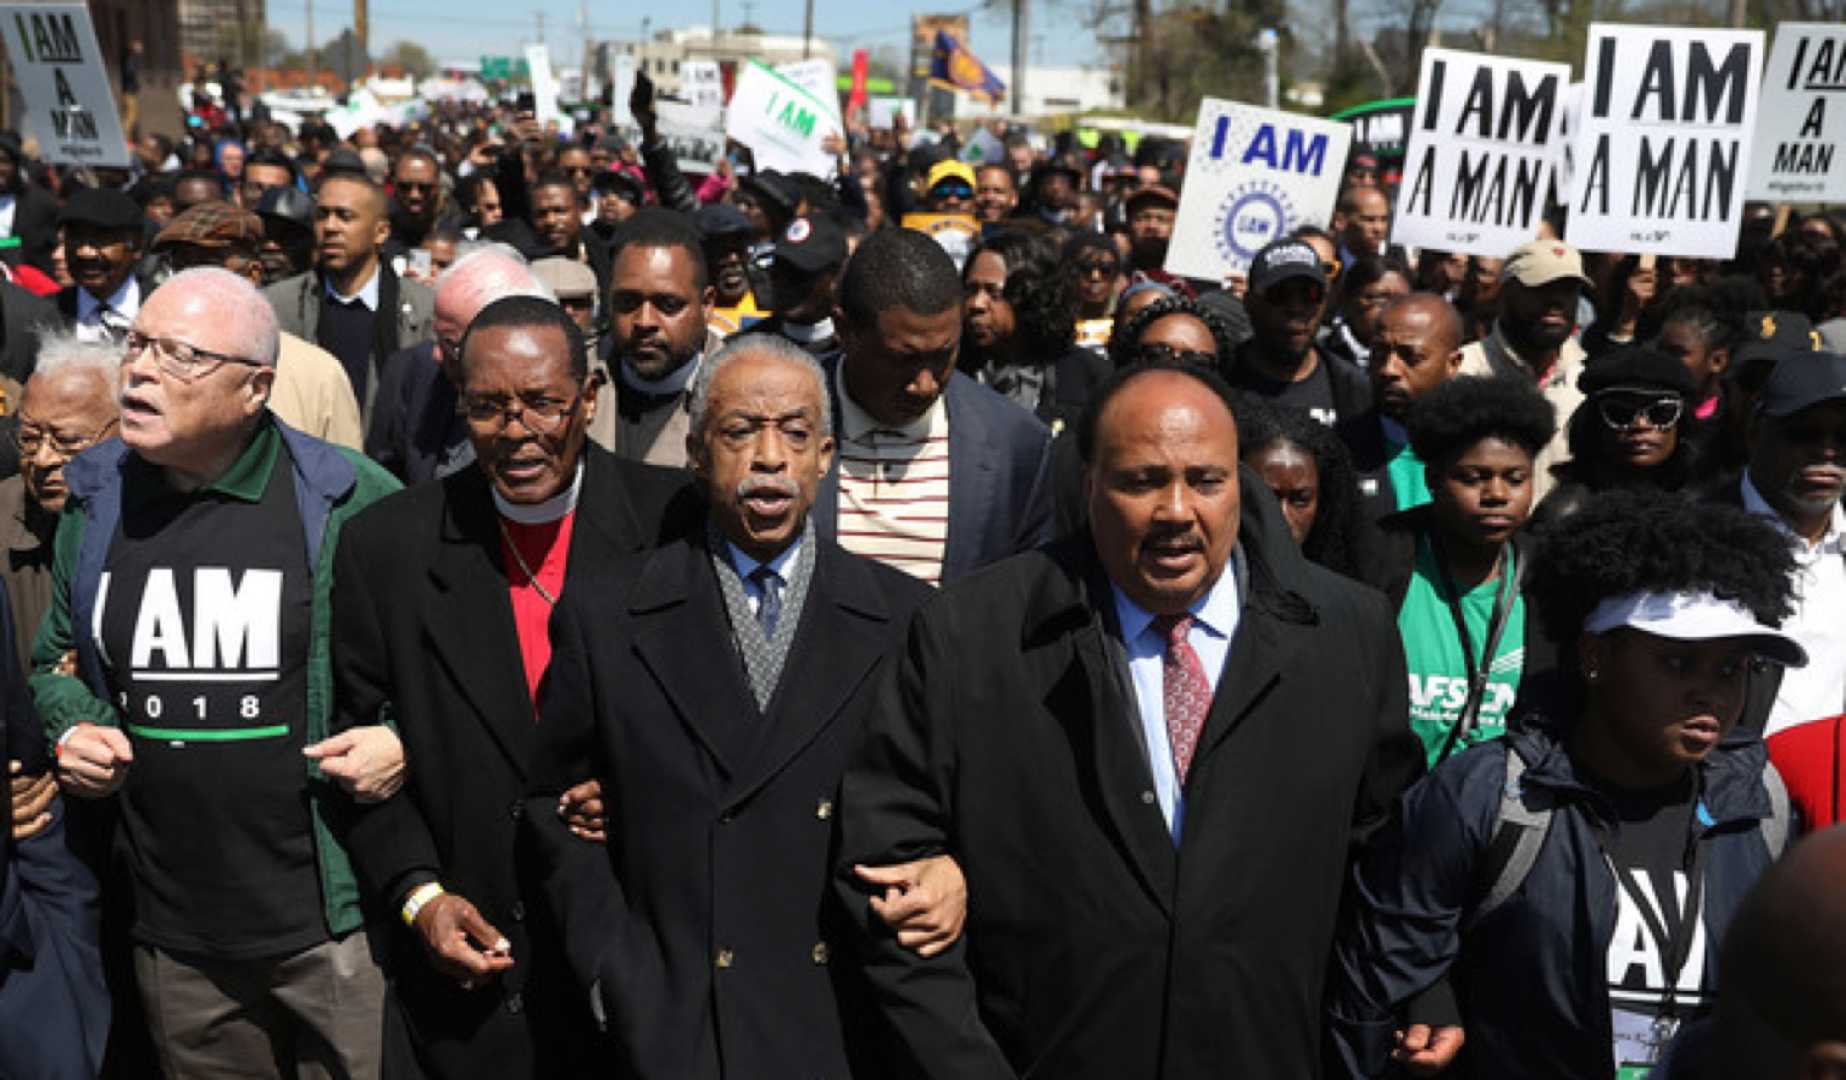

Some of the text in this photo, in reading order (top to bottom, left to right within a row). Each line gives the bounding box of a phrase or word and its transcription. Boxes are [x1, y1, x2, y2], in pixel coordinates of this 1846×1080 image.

[14, 12, 81, 62] I AM
[1786, 36, 1811, 91] I
[54, 67, 78, 106] A
[1424, 60, 1446, 130] I
[1455, 65, 1558, 145] AM
[1593, 36, 1751, 123] I AM
[777, 100, 818, 138] AM
[1799, 95, 1826, 139] A
[1209, 116, 1329, 177] I AM
[1772, 142, 1836, 174] MAN
[1406, 144, 1543, 229] A MAN
[1580, 133, 1610, 216] A
[1630, 134, 1740, 222] MAN
[131, 566, 284, 669] AM
